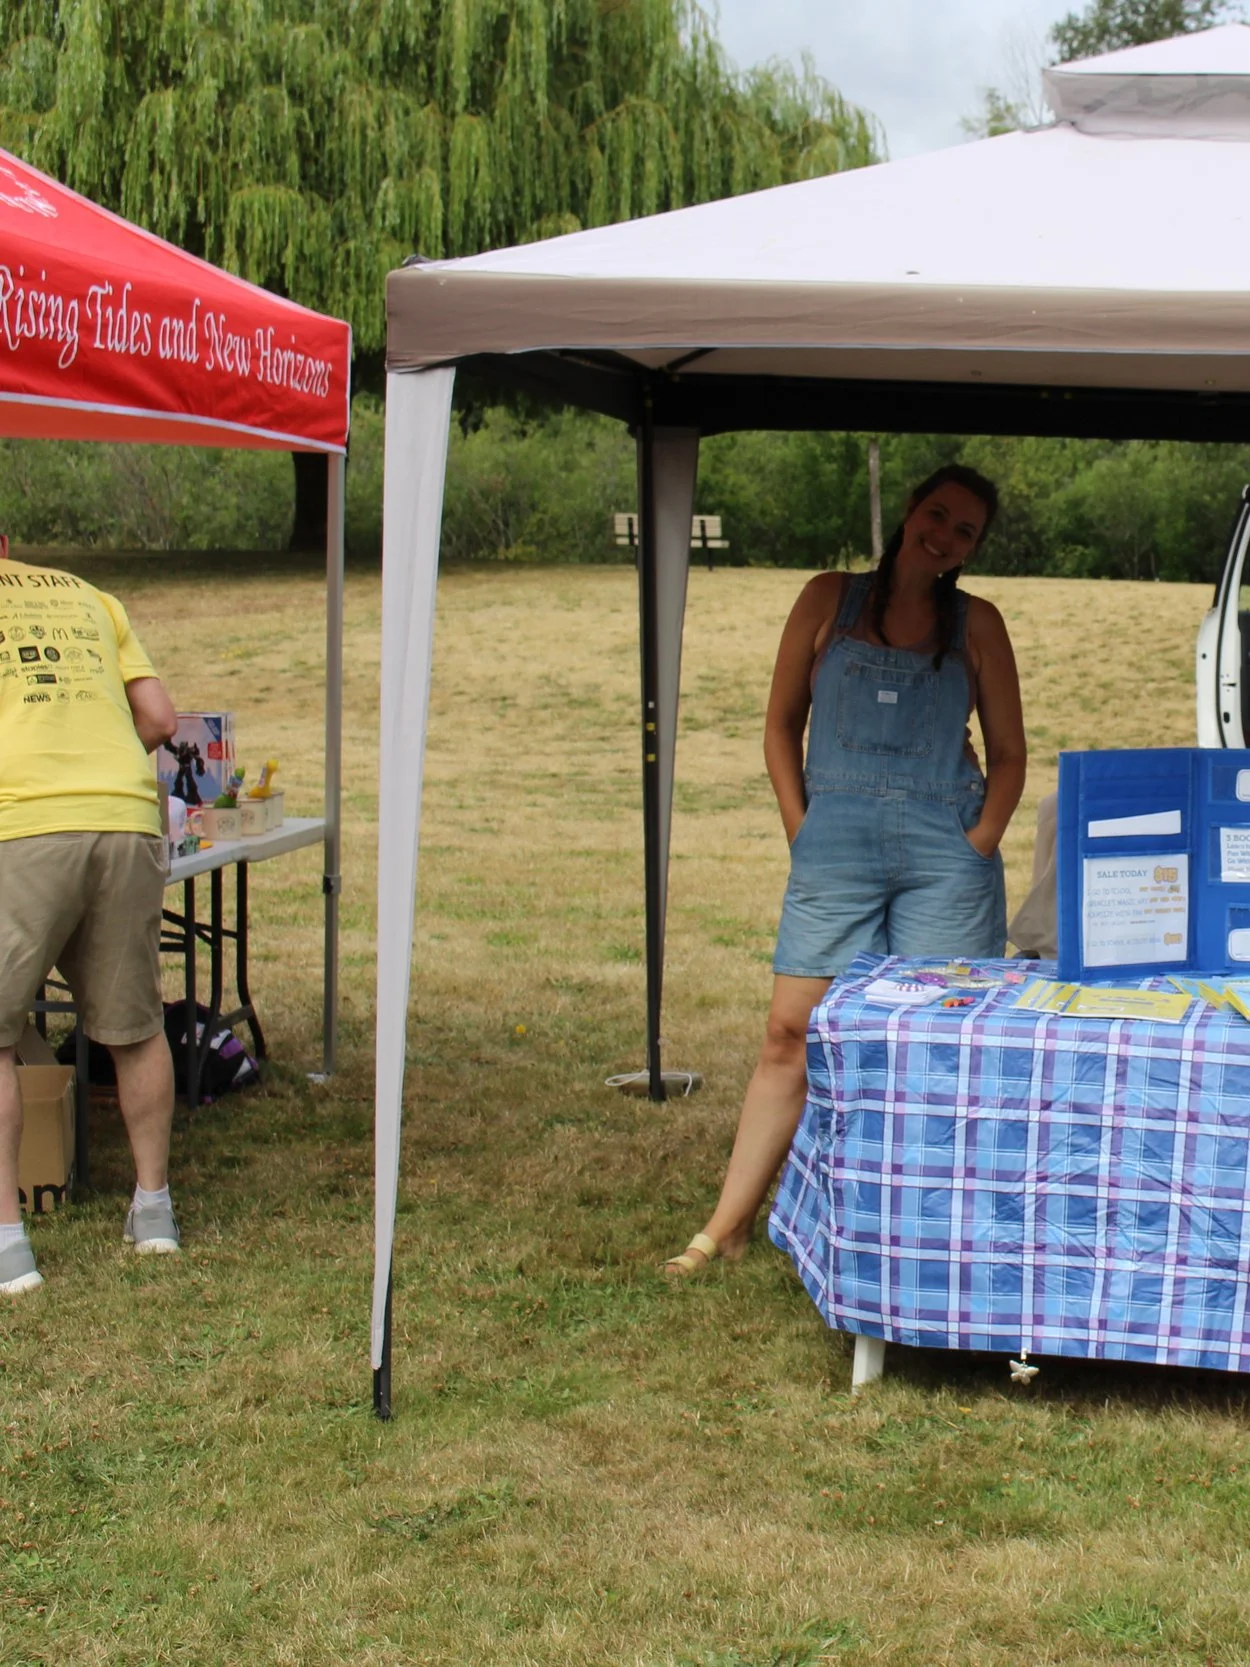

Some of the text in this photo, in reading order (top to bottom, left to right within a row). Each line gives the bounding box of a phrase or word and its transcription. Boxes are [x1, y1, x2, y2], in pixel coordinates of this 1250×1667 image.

[0, 265, 332, 398] Rising Tides and New Horizons
[27, 574, 81, 589] STAFF
[23, 691, 51, 703] NEWS
[1096, 870, 1119, 879] SALE
[1120, 869, 1148, 878] TODAY
